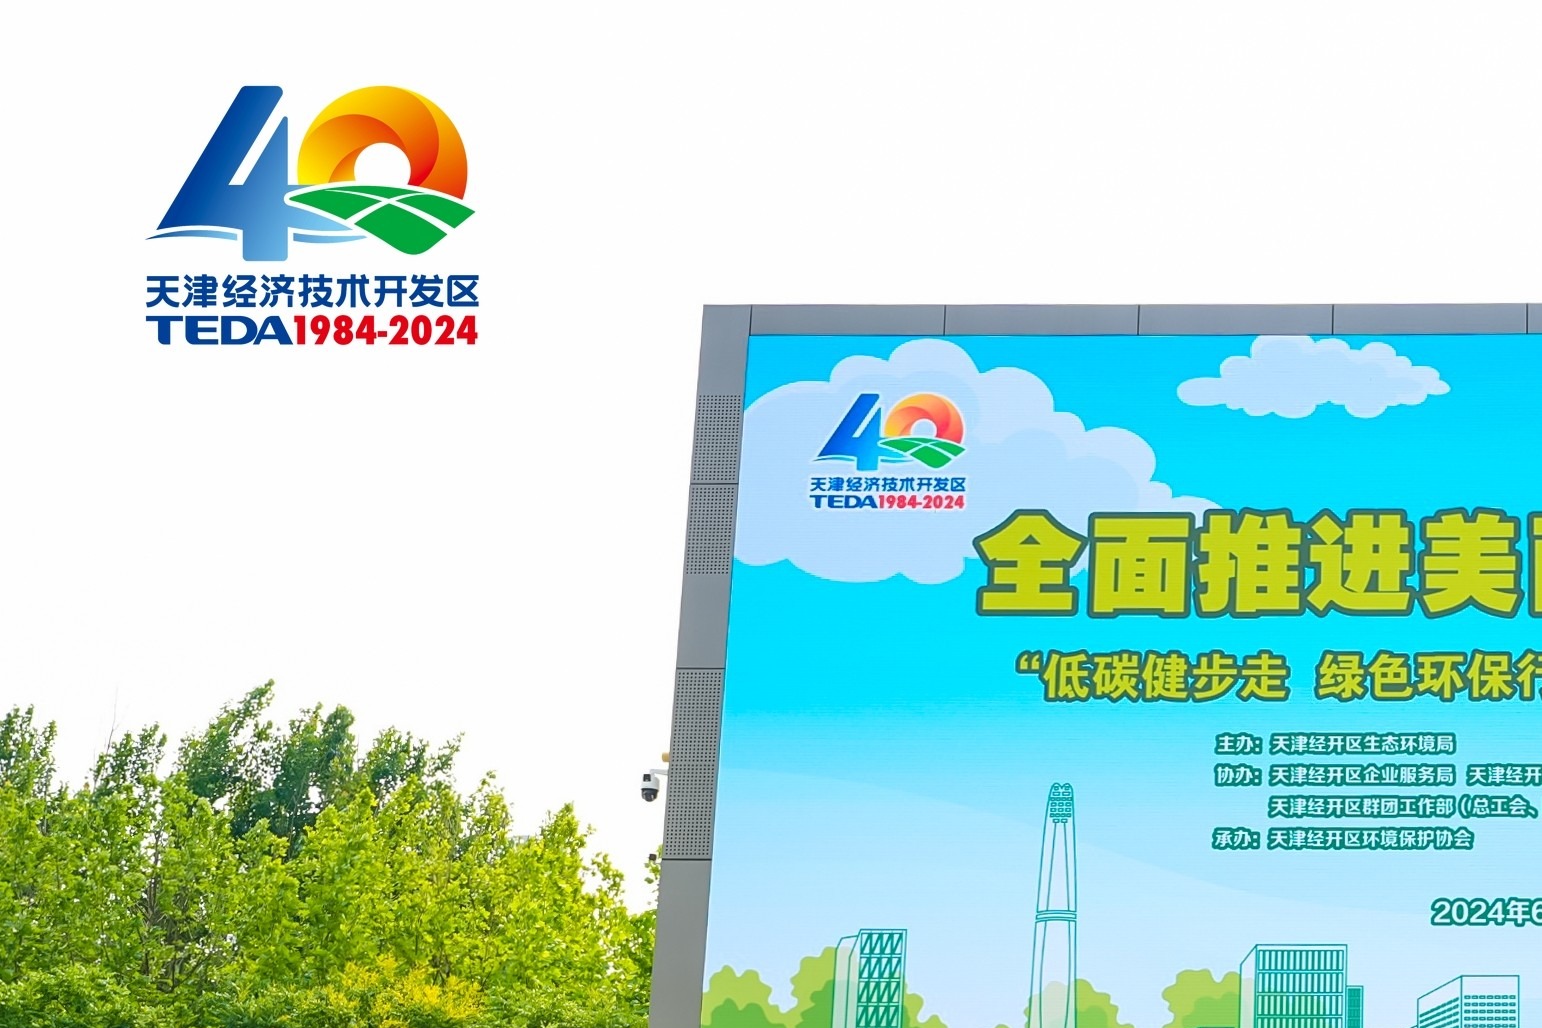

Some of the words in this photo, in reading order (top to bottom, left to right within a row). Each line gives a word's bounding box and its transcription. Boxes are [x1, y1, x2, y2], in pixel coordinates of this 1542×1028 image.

[811, 477, 966, 492] 天津经济技术开发区
[1016, 650, 1290, 701] “低碳健步走
